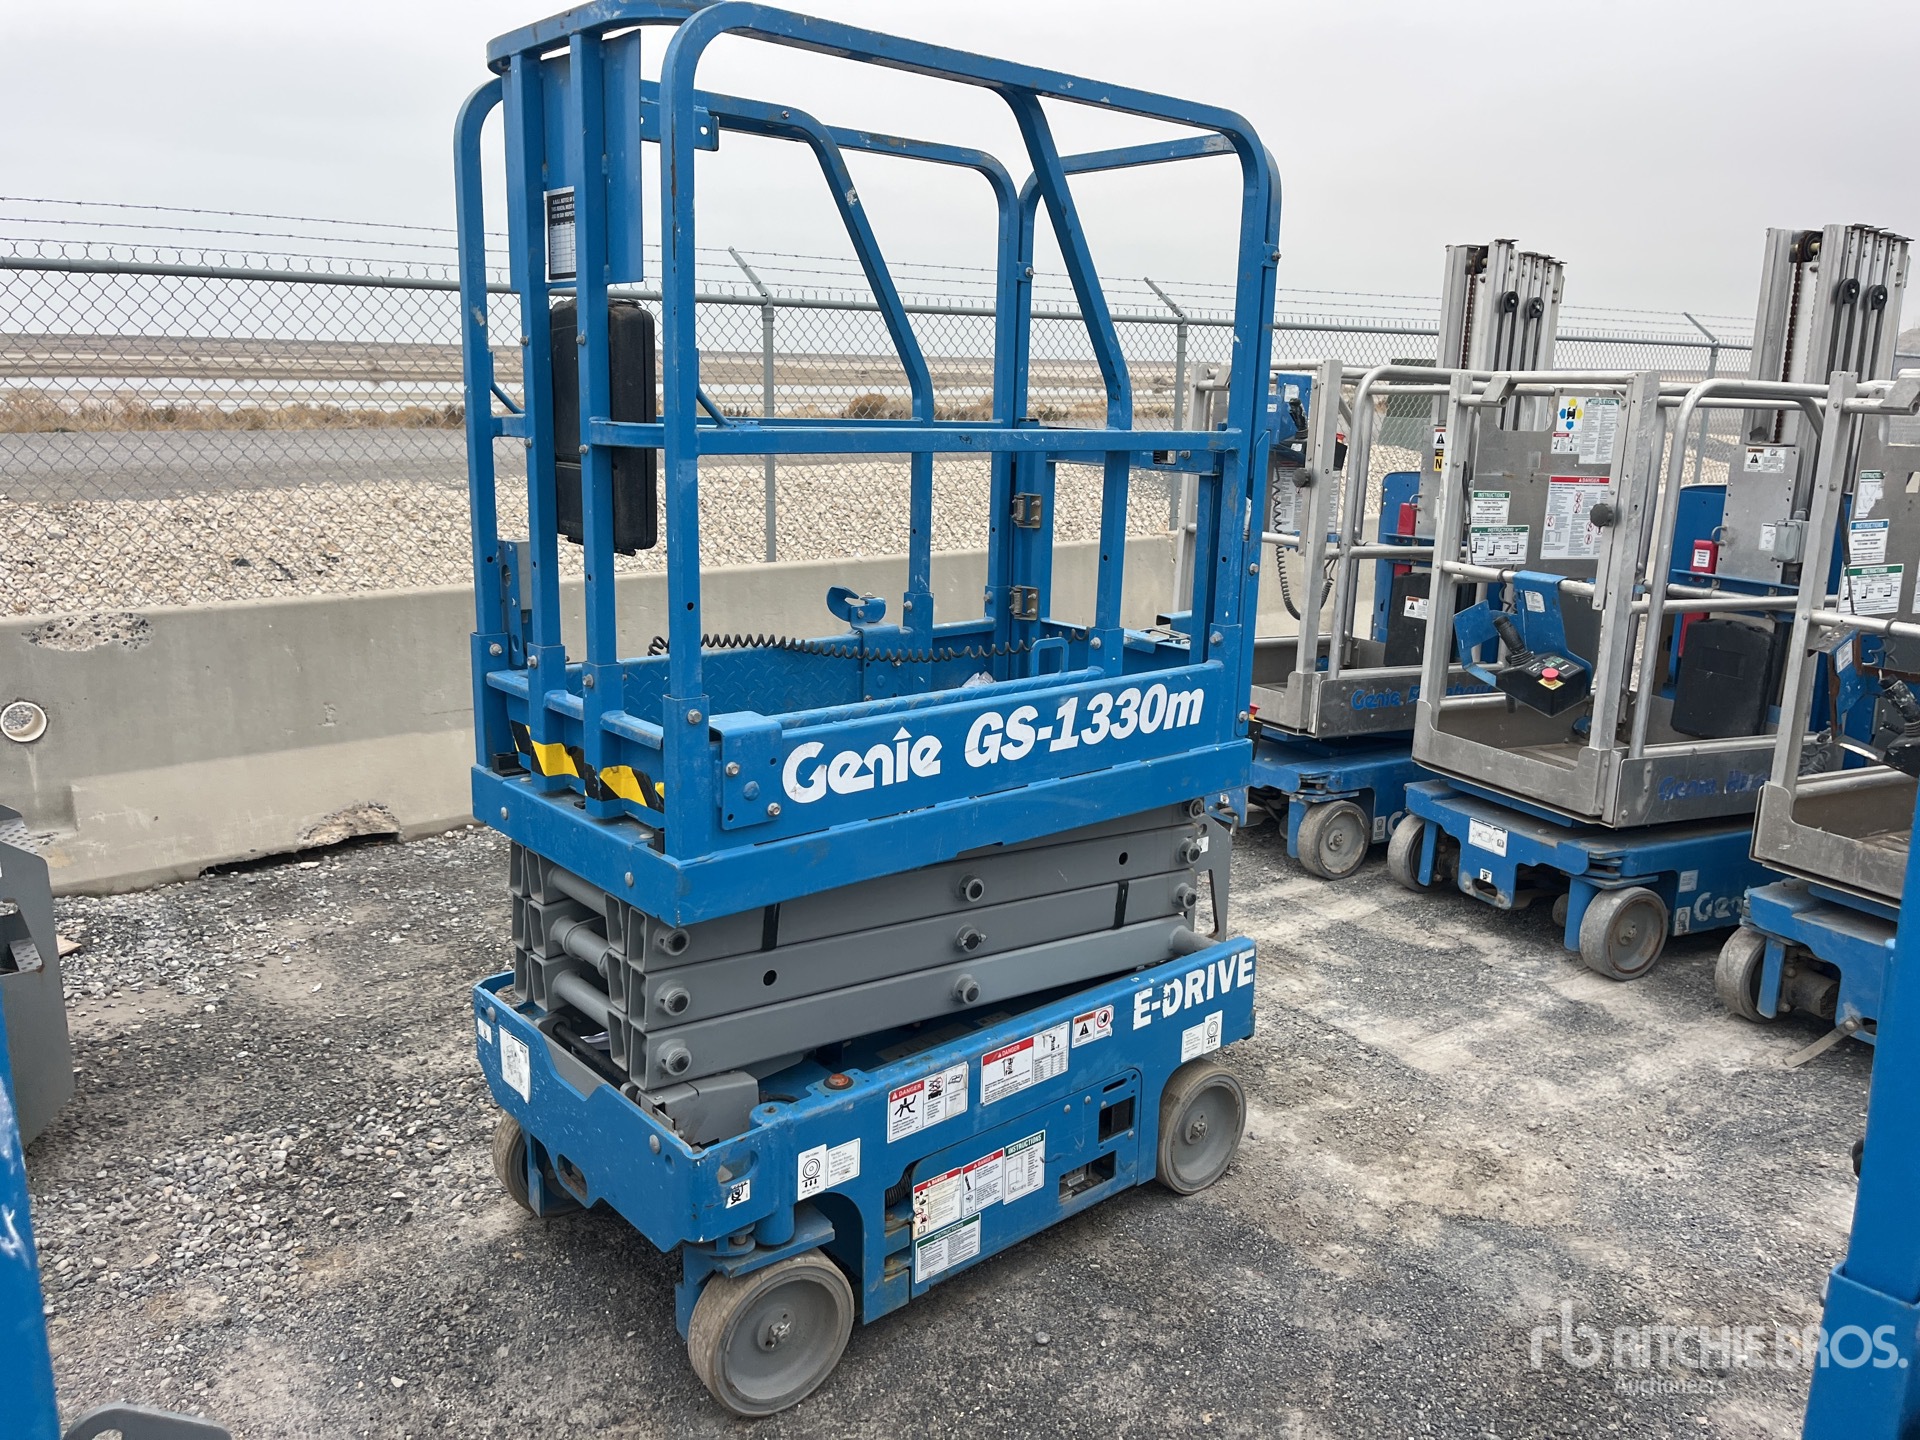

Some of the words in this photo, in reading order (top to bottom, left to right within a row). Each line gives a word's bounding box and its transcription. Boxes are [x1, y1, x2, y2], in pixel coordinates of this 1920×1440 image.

[1351, 686, 1402, 711] Genie
[782, 726, 943, 804] Genie
[964, 683, 1205, 768] GS-1330m
[1693, 891, 1743, 922] Gen
[1133, 948, 1256, 1031] E-DRIVE
[1001, 1044, 1021, 1057] DANGER
[898, 1083, 922, 1098] DANGER
[1007, 1134, 1042, 1154] INSTRUCTIONS
[977, 1154, 995, 1168] DANGER
[931, 1174, 948, 1186] DANGER
[933, 1222, 965, 1240] INSTRUCTIONS
